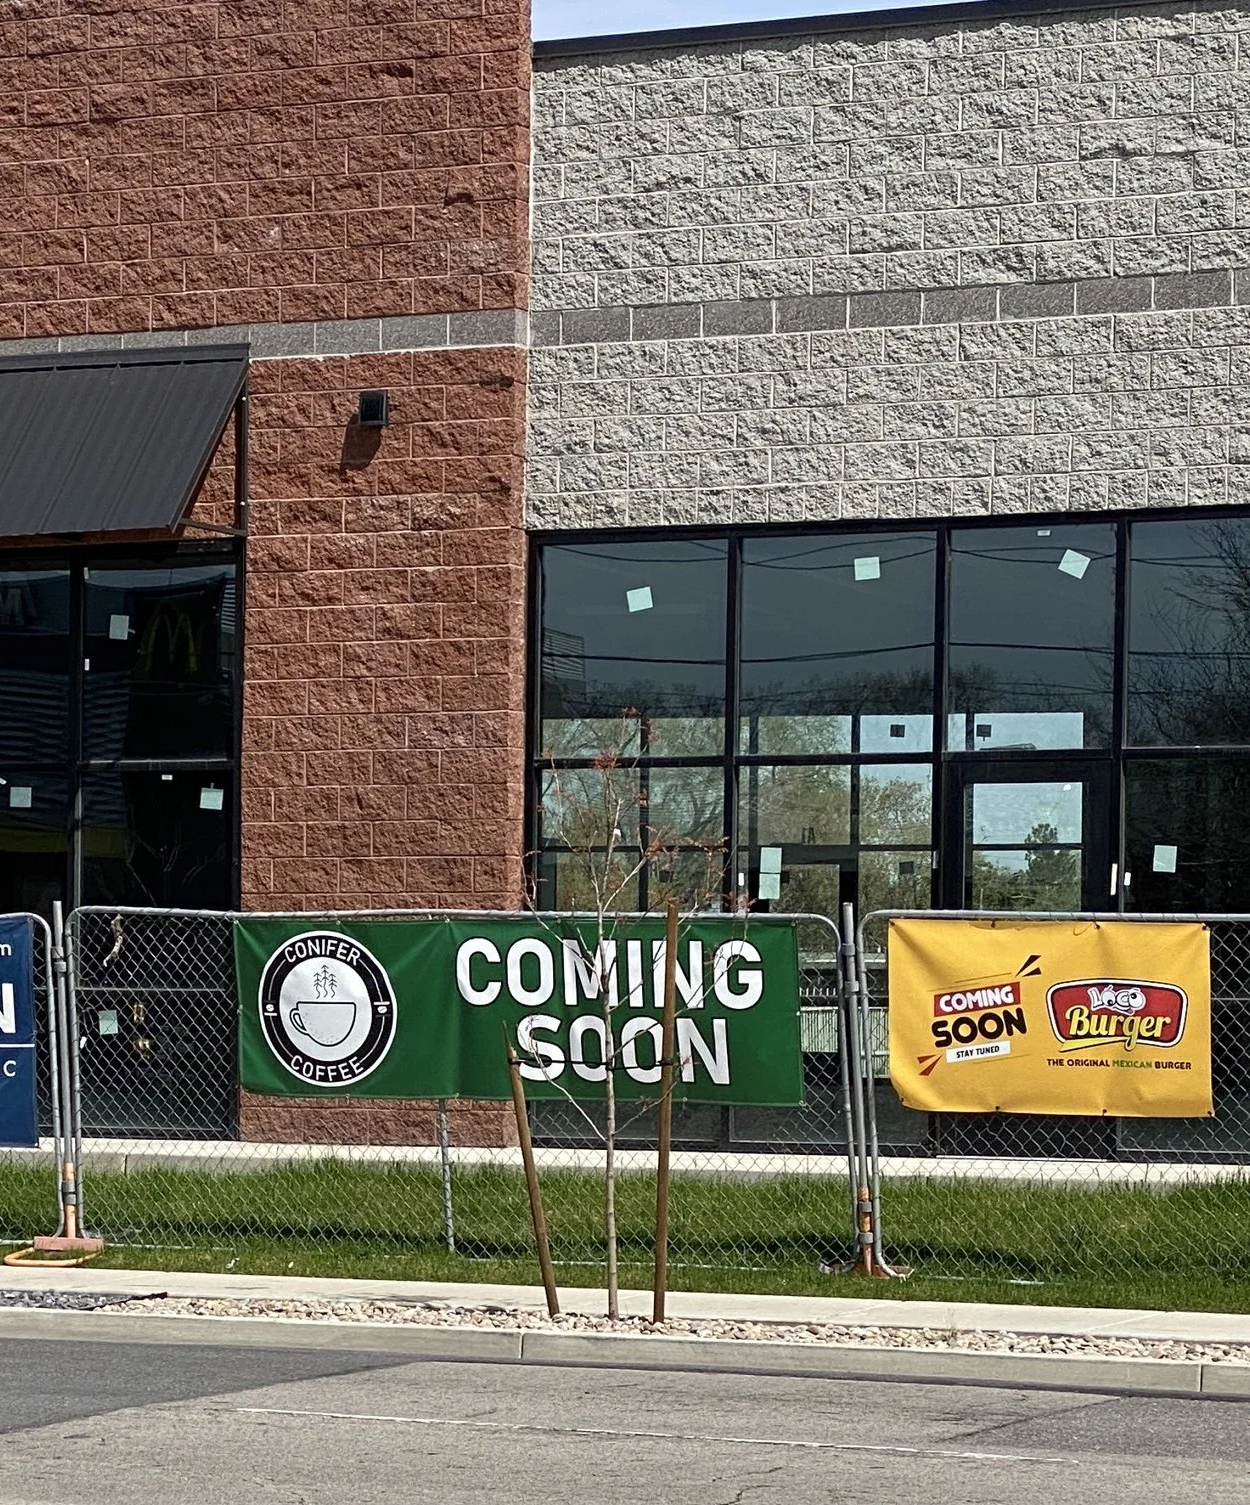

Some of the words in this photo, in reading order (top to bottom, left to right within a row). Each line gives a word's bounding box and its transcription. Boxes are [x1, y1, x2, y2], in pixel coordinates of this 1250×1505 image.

[284, 938, 361, 966] CONIFER
[456, 936, 764, 1010] COMING
[939, 985, 1015, 1012] COMING
[931, 1007, 1028, 1048] SOON
[1065, 1004, 1172, 1051] Burger
[516, 1014, 731, 1086] SOON
[956, 1048, 974, 1058] STAY
[975, 1045, 1000, 1056] TUNED
[1046, 1058, 1065, 1067] THE
[1066, 1058, 1111, 1067] ORIGINAL
[1112, 1060, 1152, 1068] MEXICAN
[1154, 1061, 1192, 1070] BURGER
[290, 1055, 364, 1082] COFFEE
